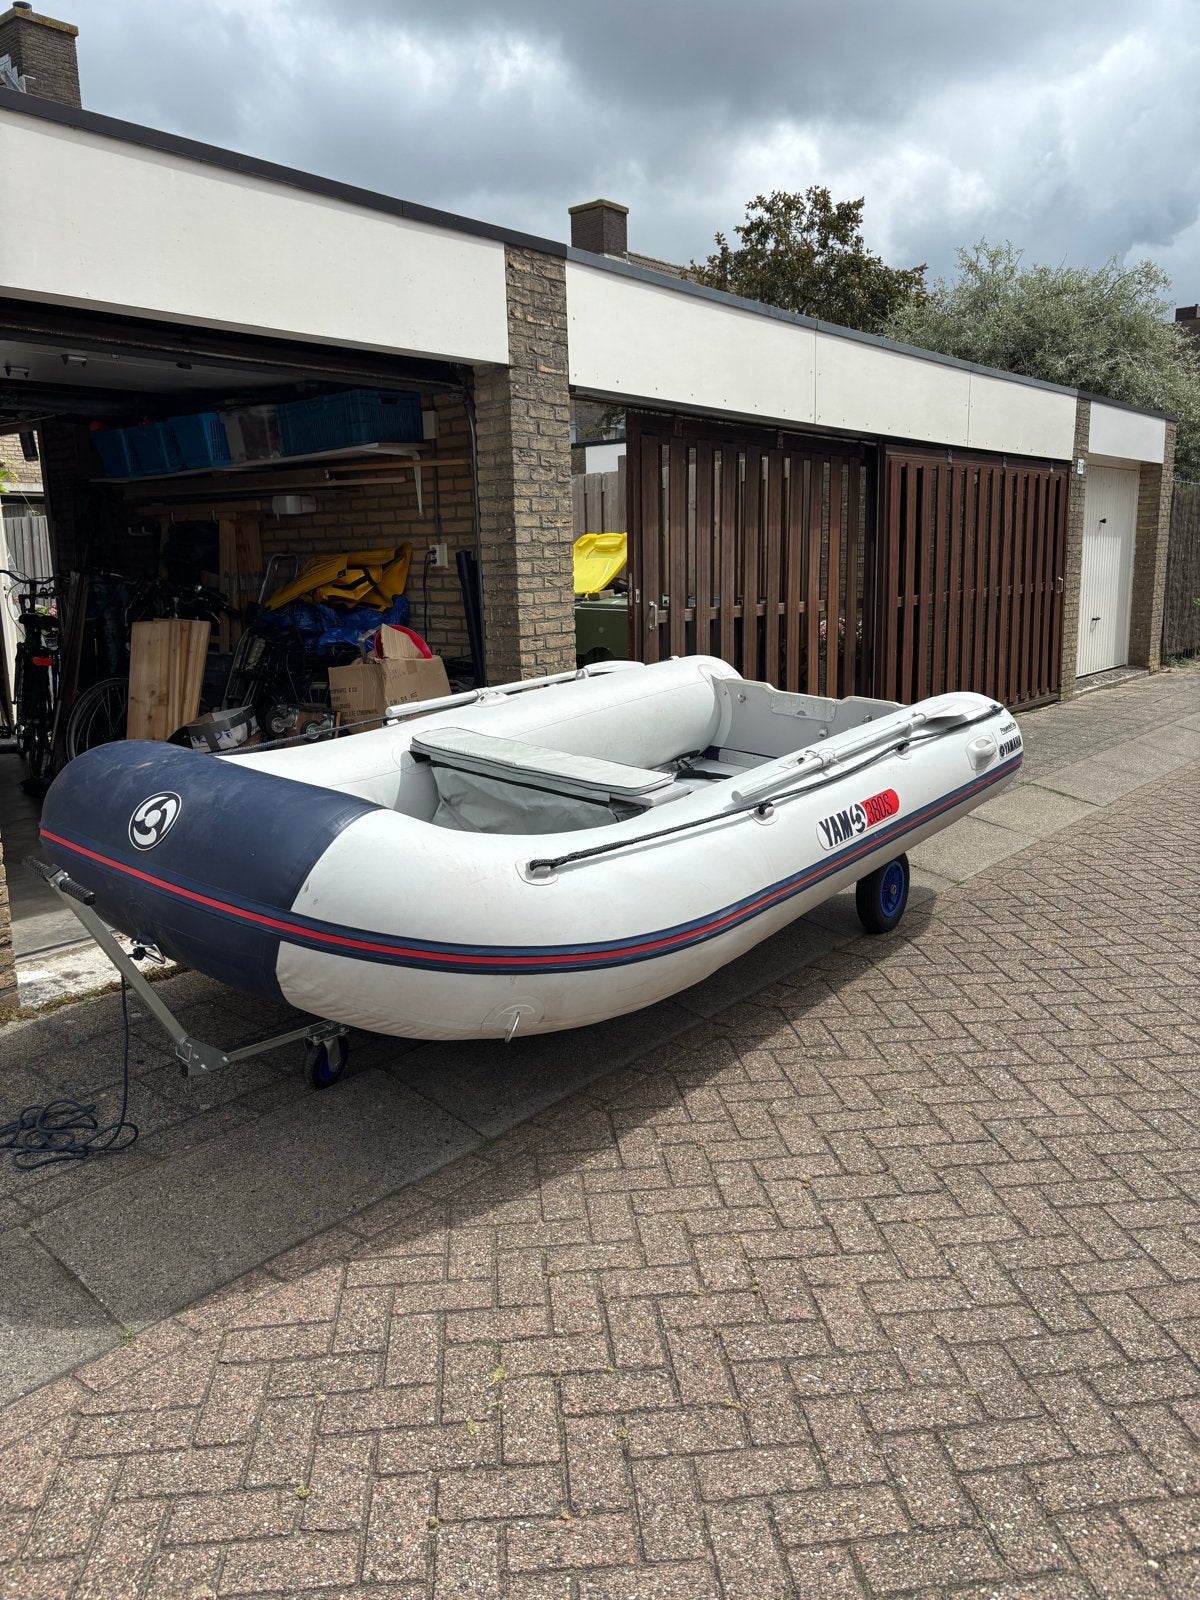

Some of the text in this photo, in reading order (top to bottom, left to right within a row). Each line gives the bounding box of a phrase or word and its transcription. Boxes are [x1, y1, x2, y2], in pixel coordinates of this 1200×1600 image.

[1004, 733, 1022, 751] YAMAHA
[819, 793, 893, 847] YAM 380S
